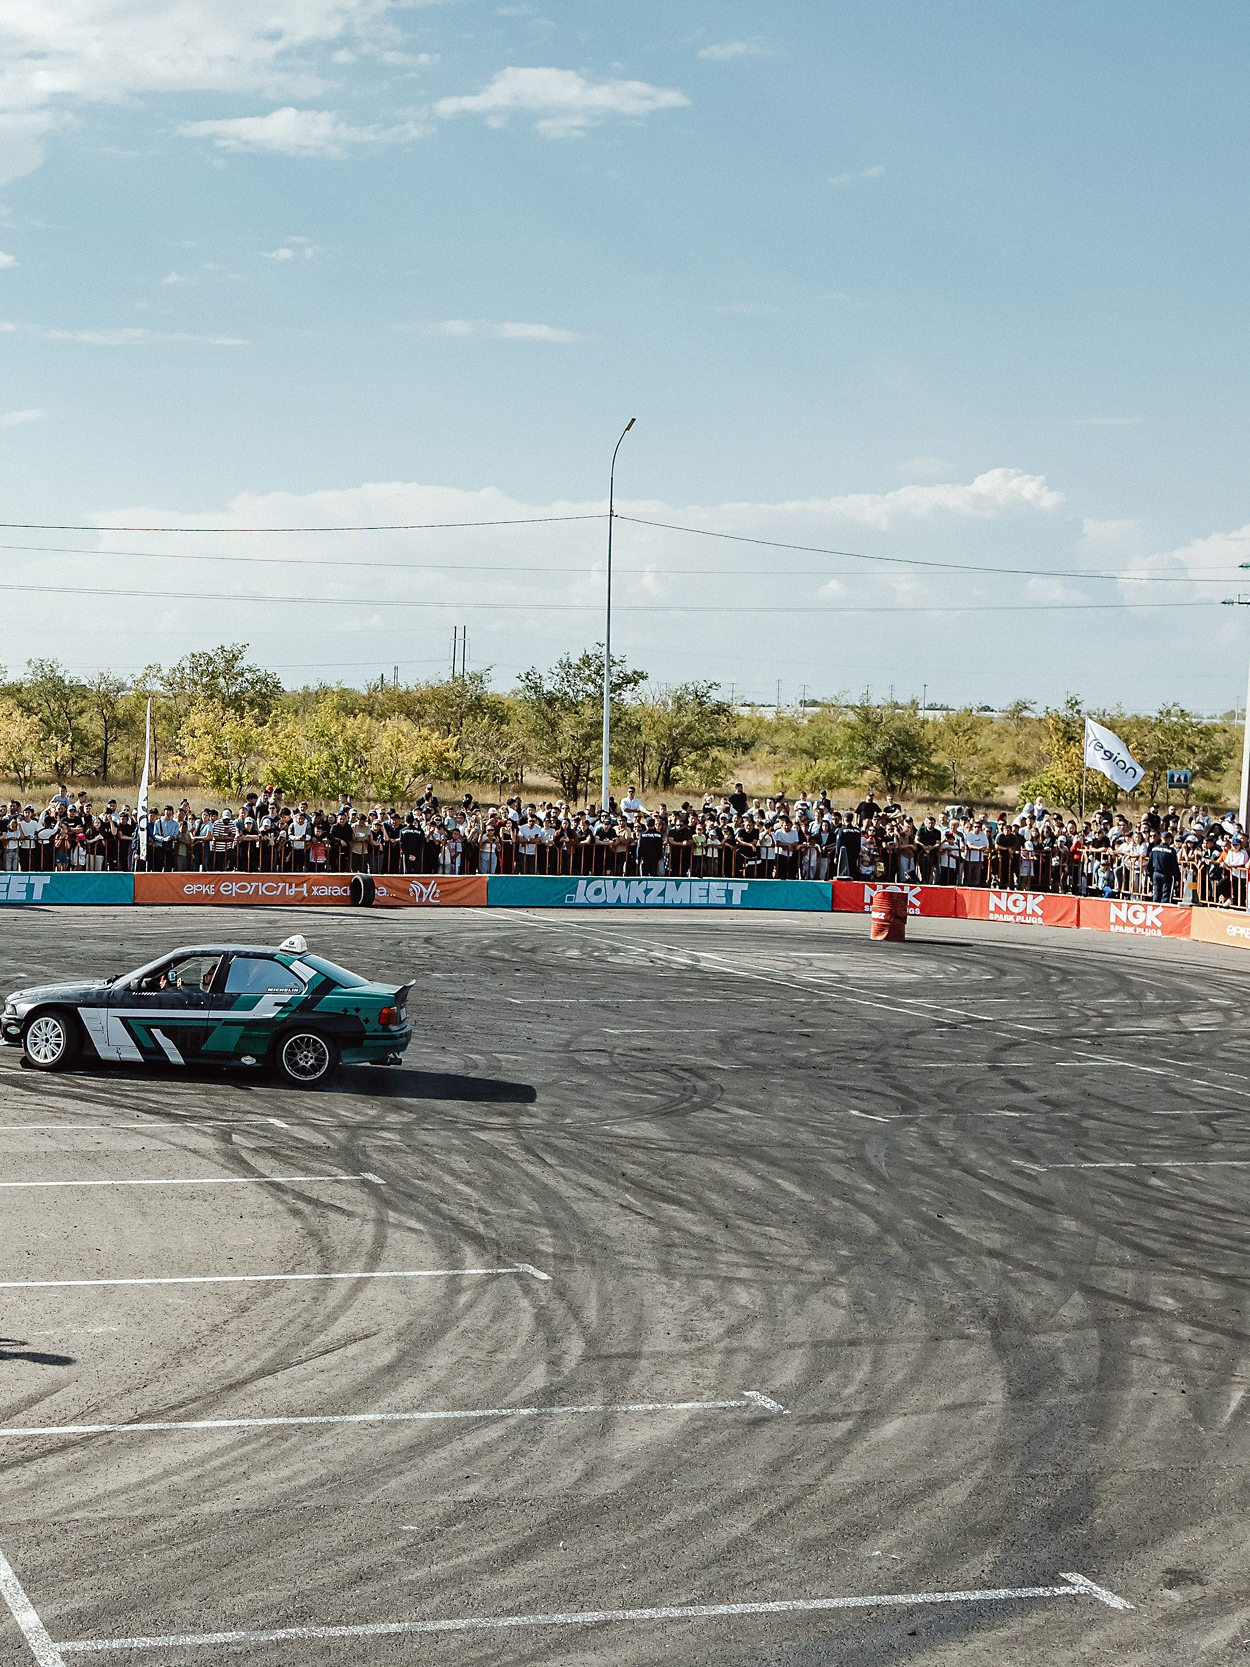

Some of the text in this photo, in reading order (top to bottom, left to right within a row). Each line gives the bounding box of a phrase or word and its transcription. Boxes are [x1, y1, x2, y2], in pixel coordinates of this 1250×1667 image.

[863, 884, 922, 907] NK
[989, 891, 1044, 916] NGK
[989, 913, 1044, 924] SPARK PLUGS
[1109, 903, 1164, 928] NGK
[1109, 925, 1163, 937] SPARK PLUGS
